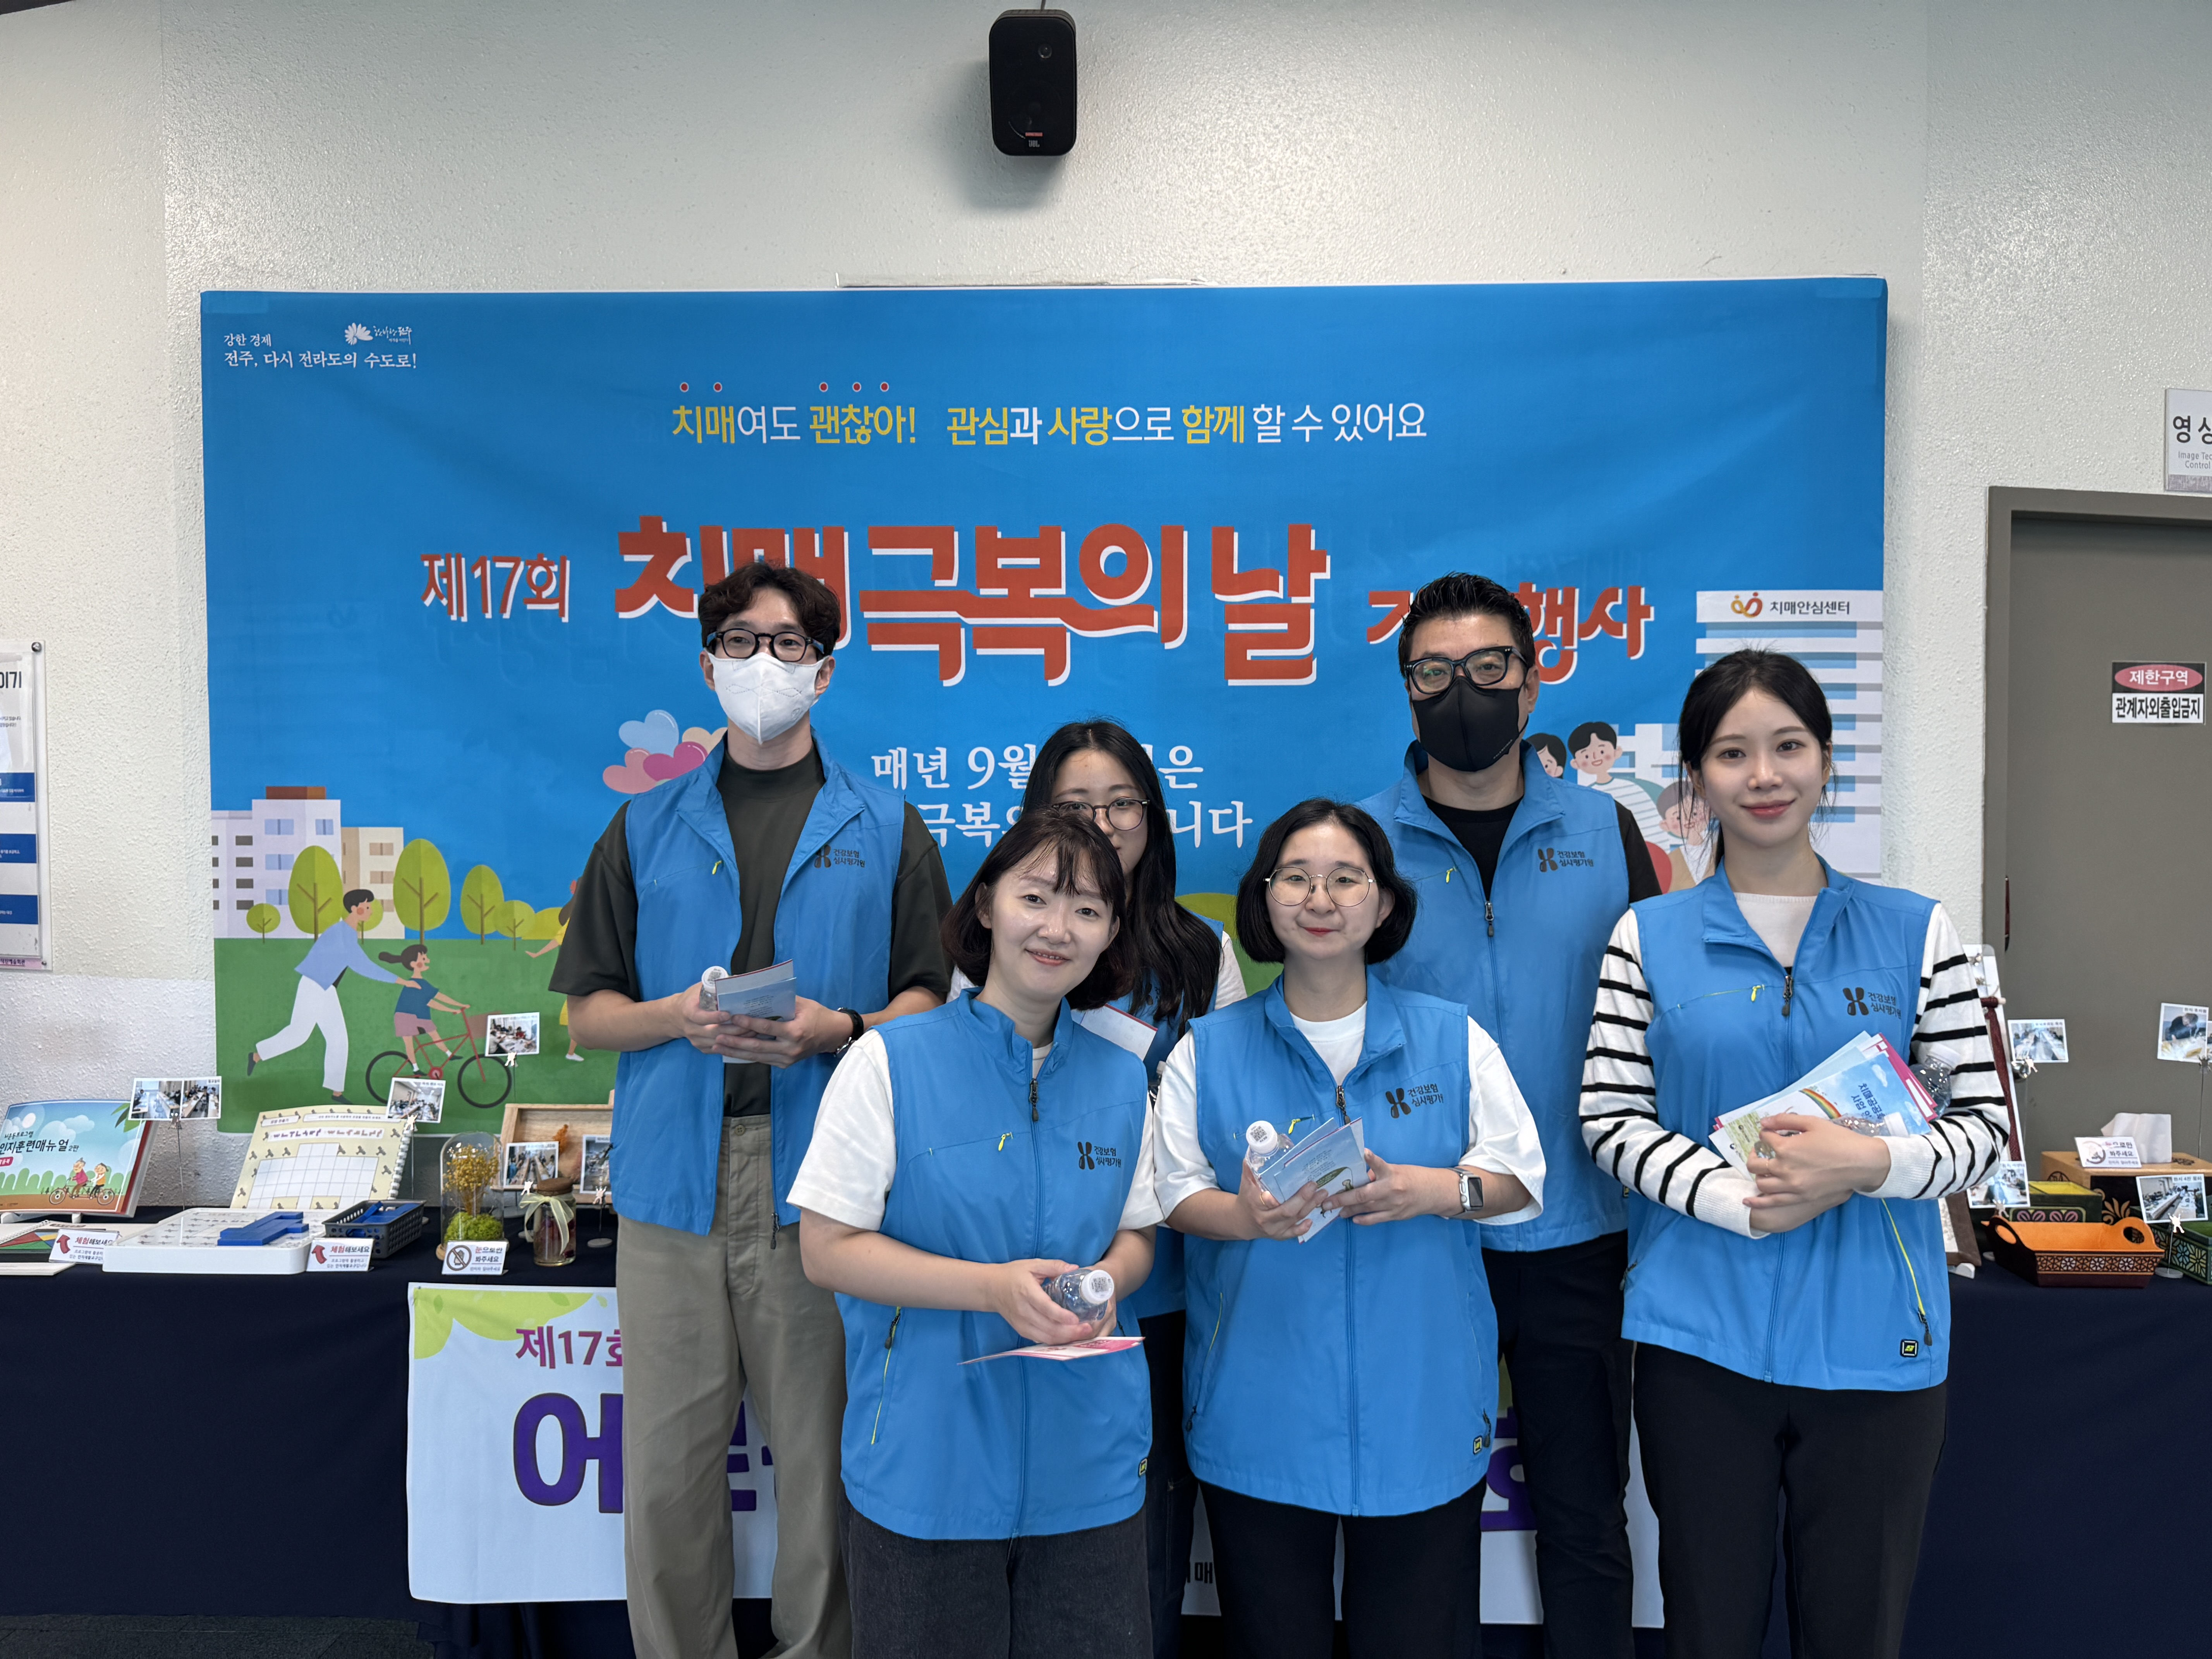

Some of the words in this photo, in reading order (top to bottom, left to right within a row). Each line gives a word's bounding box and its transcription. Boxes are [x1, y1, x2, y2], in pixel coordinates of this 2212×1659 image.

[224, 333, 247, 346] 강한
[250, 334, 271, 347] 경제
[224, 351, 258, 368] 전주,
[264, 351, 293, 368] 다시
[299, 351, 357, 368] 전라도의
[364, 352, 416, 369] 수도로!
[672, 405, 801, 443] 치매여도
[809, 404, 915, 445] 괜찮아!
[946, 407, 1042, 446] 관심과
[1048, 407, 1174, 447] 사랑으로
[1181, 404, 1244, 445] 함께
[1252, 403, 1286, 444] 할
[1291, 404, 1324, 443] 수
[1331, 402, 1427, 443] 있어요
[2178, 451, 2199, 460] Image
[2185, 460, 2211, 469] Control
[420, 552, 570, 622] 제17회
[1211, 523, 1331, 686] 날
[1770, 601, 1850, 615] 치매안심센터
[2130, 669, 2188, 686] 제한구역
[2116, 696, 2200, 719] 관계자외출입금지
[871, 746, 950, 791] 매년
[967, 743, 1037, 790] 9월
[833, 848, 859, 858] 건강보험
[1557, 850, 1585, 859] 건강보험
[833, 857, 865, 867] 심사평가원
[1559, 859, 1594, 867] 심사평가원
[1867, 992, 1896, 1006] 건강보험
[1870, 1002, 1901, 1020] 심사평가원
[1407, 1083, 1439, 1097] 건강보험
[1851, 1094, 1867, 1110] 사업
[1094, 1146, 1116, 1156] 건강보험
[1096, 1156, 1121, 1168] 심사평가원
[330, 1245, 370, 1254] 체험해보세요
